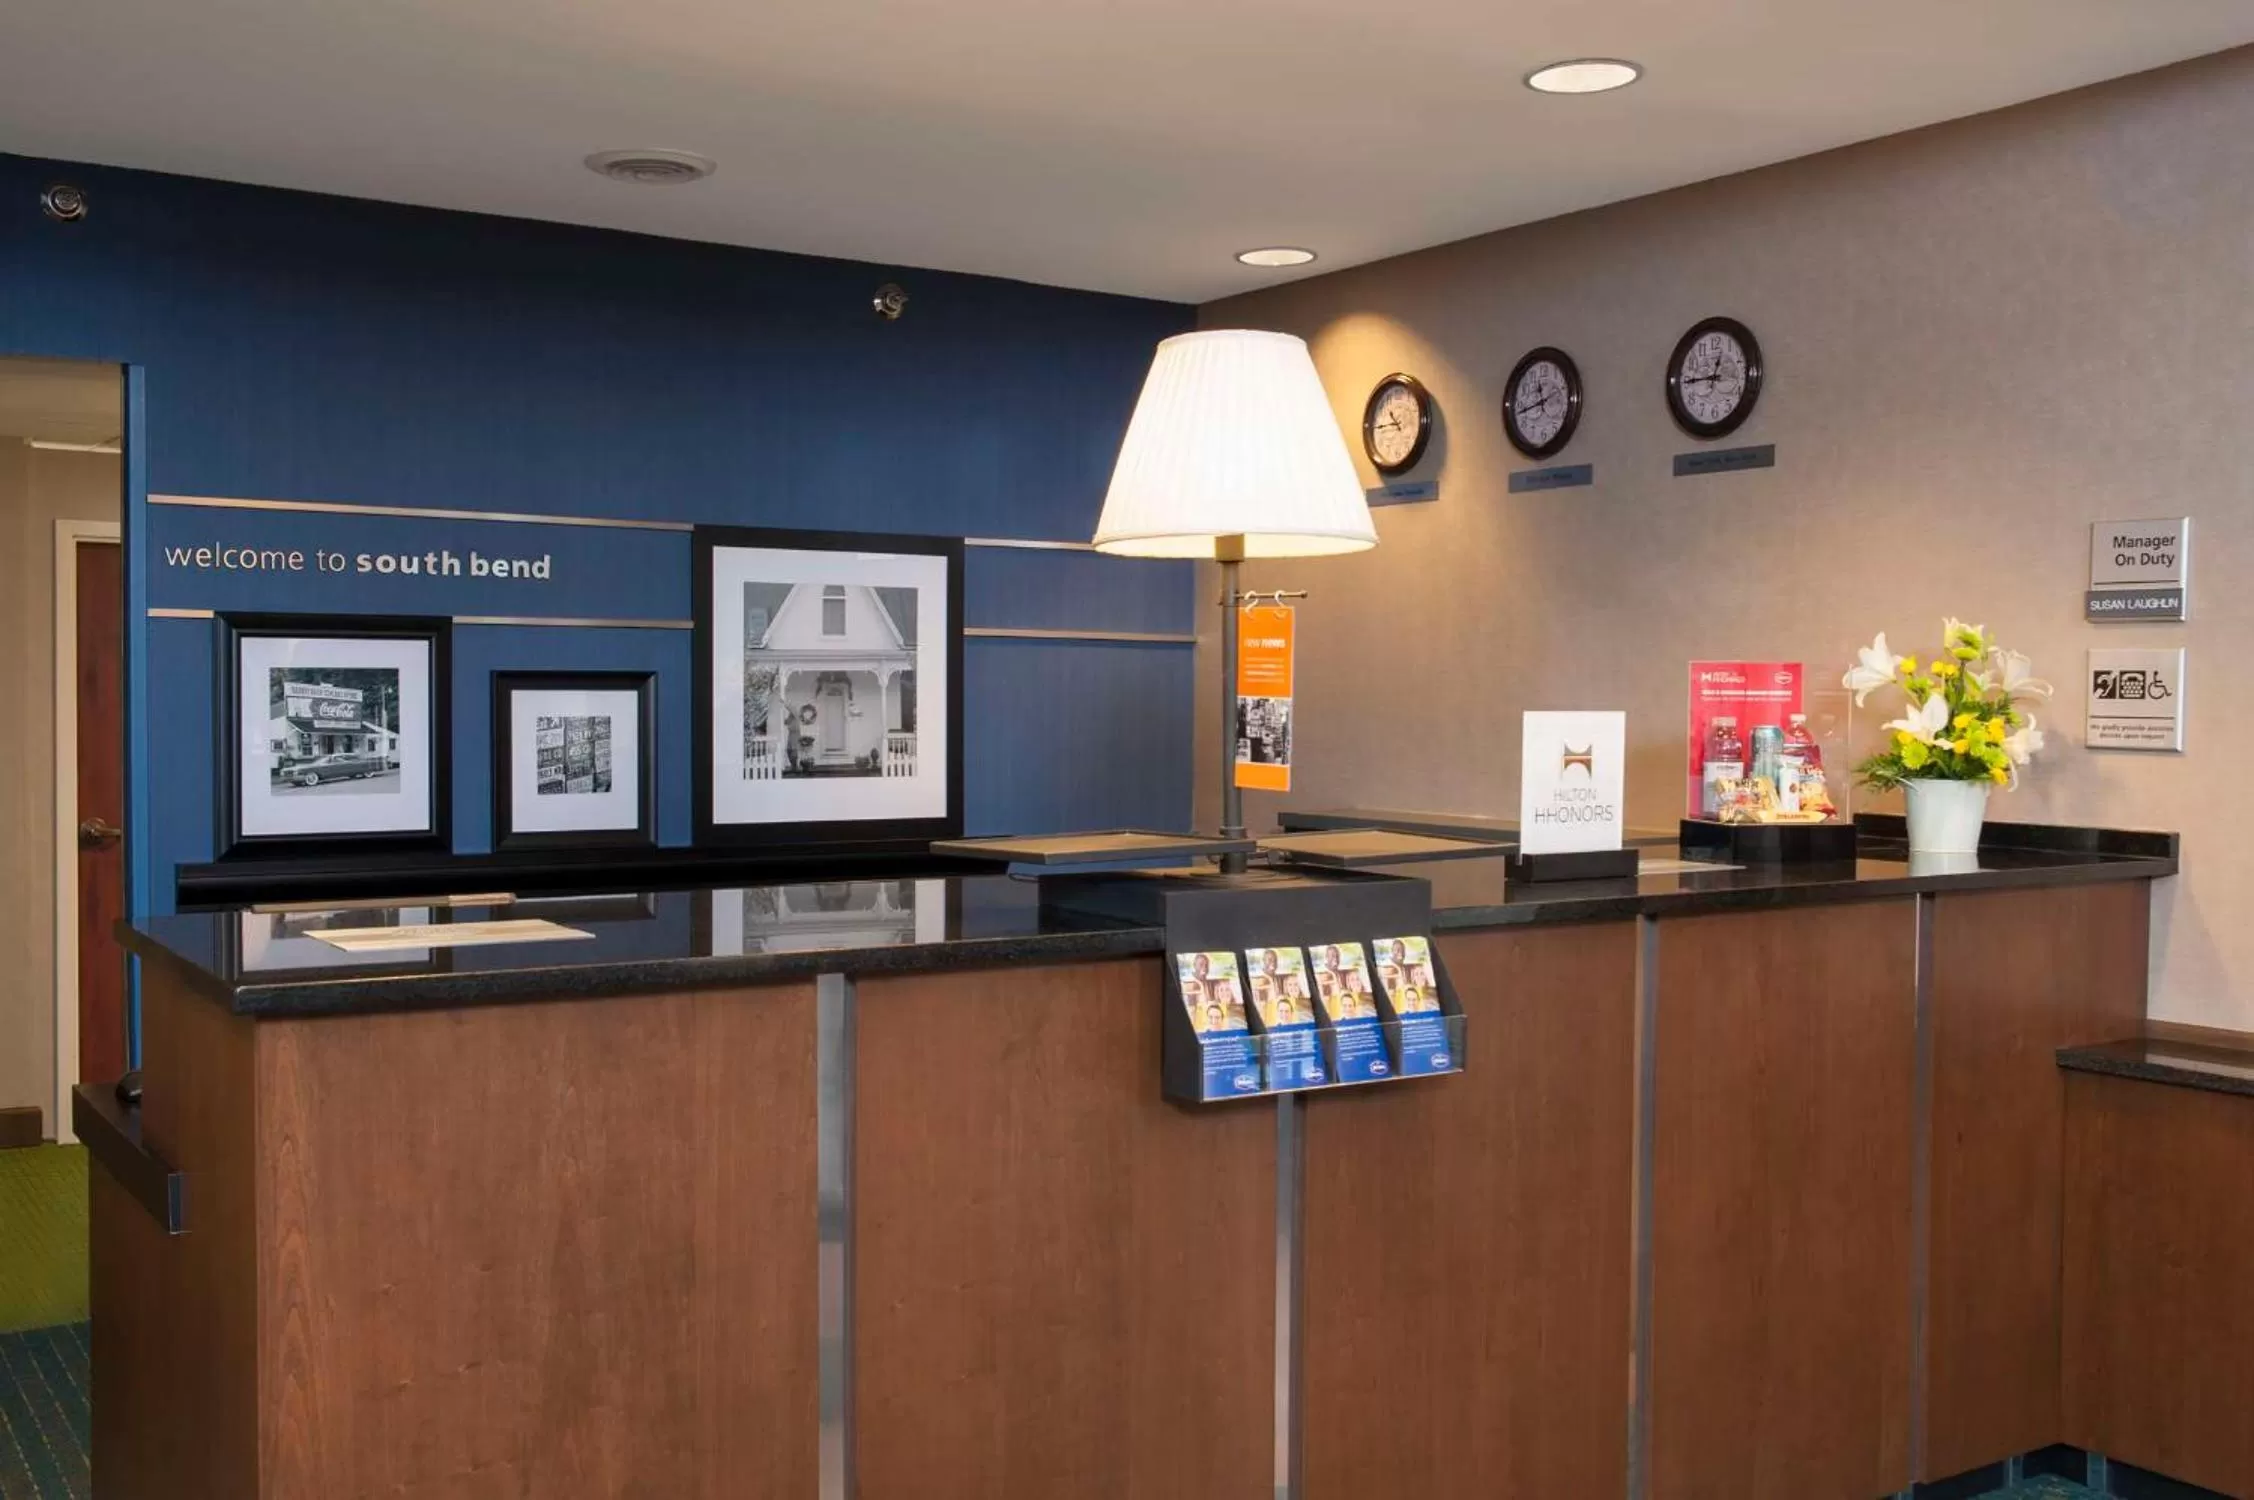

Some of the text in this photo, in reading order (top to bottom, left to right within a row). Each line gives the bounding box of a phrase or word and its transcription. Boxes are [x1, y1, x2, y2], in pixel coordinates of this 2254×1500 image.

[2112, 535, 2177, 552] Manager
[164, 542, 552, 579] welcome to south bend
[2114, 552, 2175, 568] On Duty
[2090, 598, 2126, 611] SUSAN
[1554, 788, 1597, 803] HILTON
[1534, 805, 1614, 824] HHONORS
